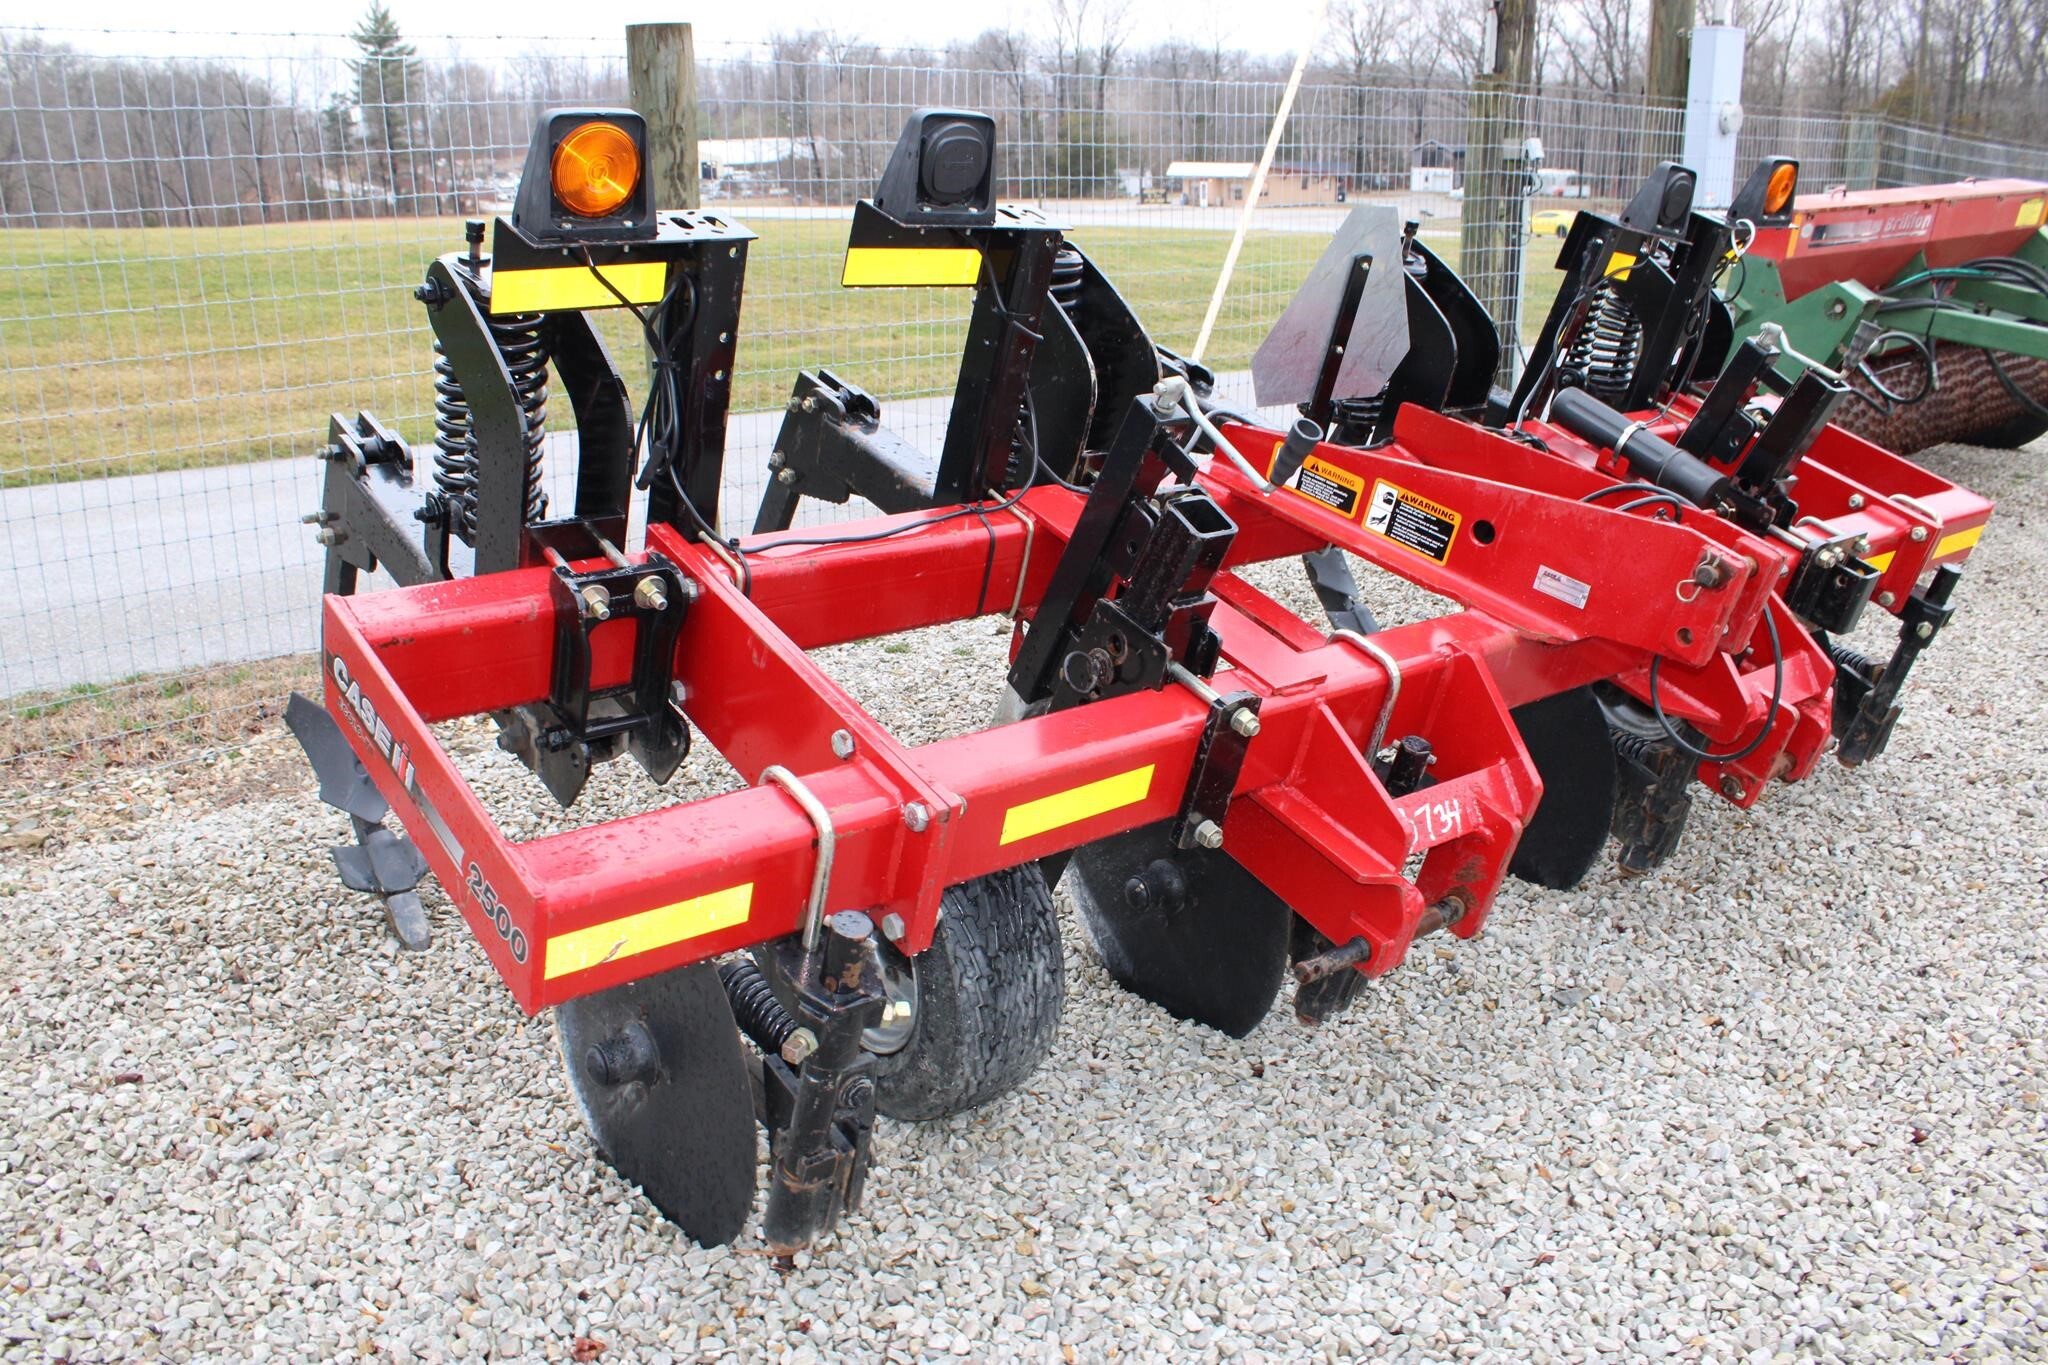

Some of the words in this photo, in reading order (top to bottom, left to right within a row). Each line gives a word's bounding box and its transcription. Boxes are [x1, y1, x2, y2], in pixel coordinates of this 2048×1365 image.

[1883, 211, 1932, 232] Brillion
[1321, 466, 1355, 487] WARNING
[1410, 495, 1455, 521] WARNING
[333, 656, 392, 760] CASE
[465, 861, 528, 965] 2500
